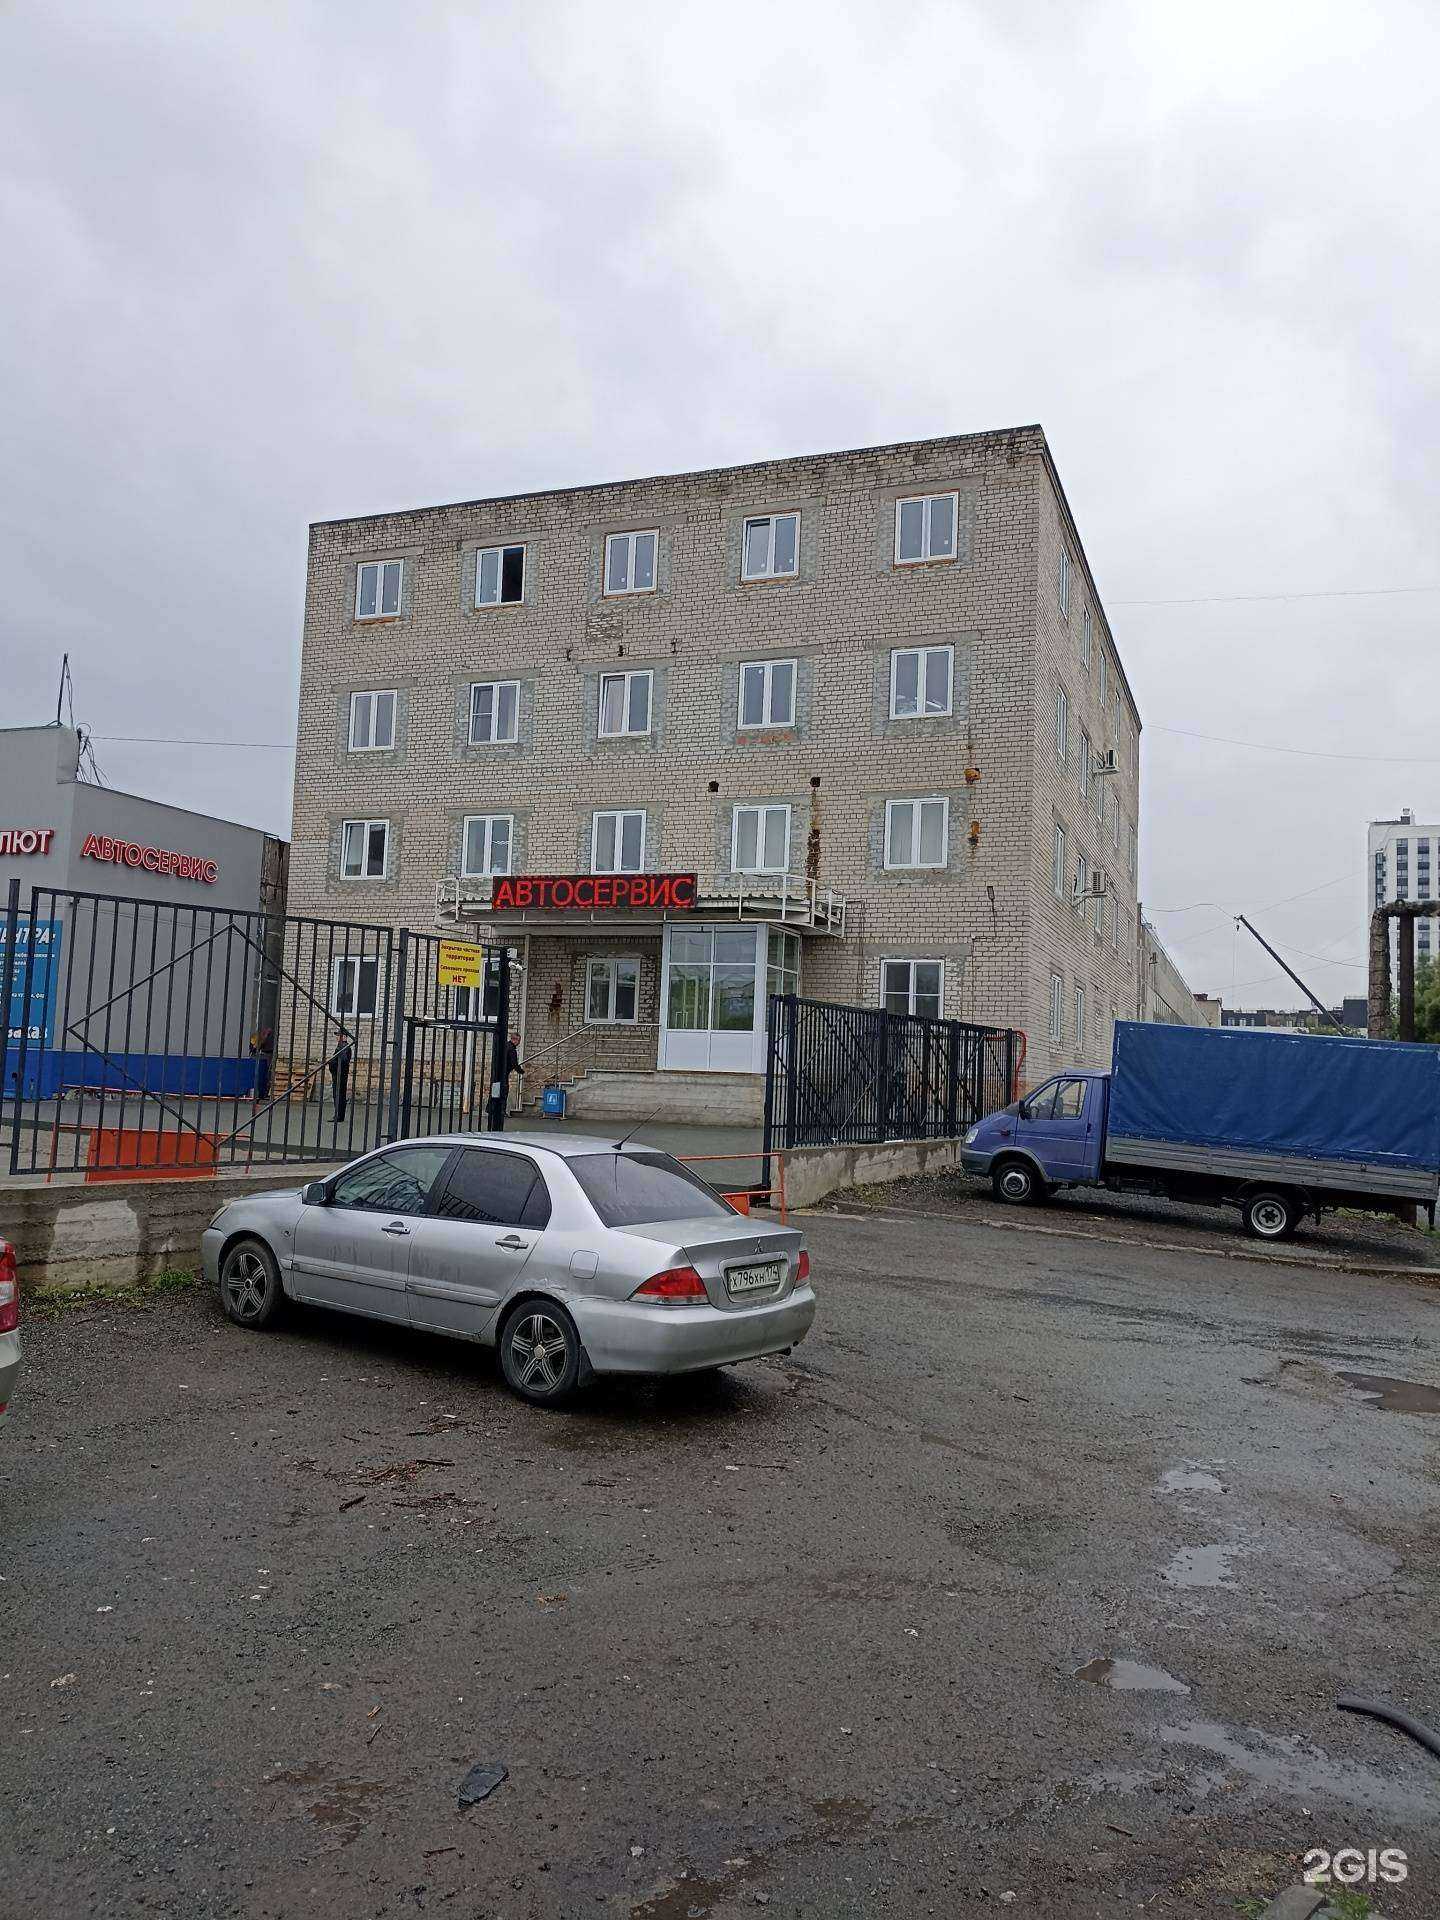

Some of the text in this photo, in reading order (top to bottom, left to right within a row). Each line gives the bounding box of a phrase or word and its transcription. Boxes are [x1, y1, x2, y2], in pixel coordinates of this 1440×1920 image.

[82, 833, 219, 884] АВТОСЕРВИС
[496, 878, 692, 907] АВТОСЕРВИС
[452, 975, 467, 983] НЕТ
